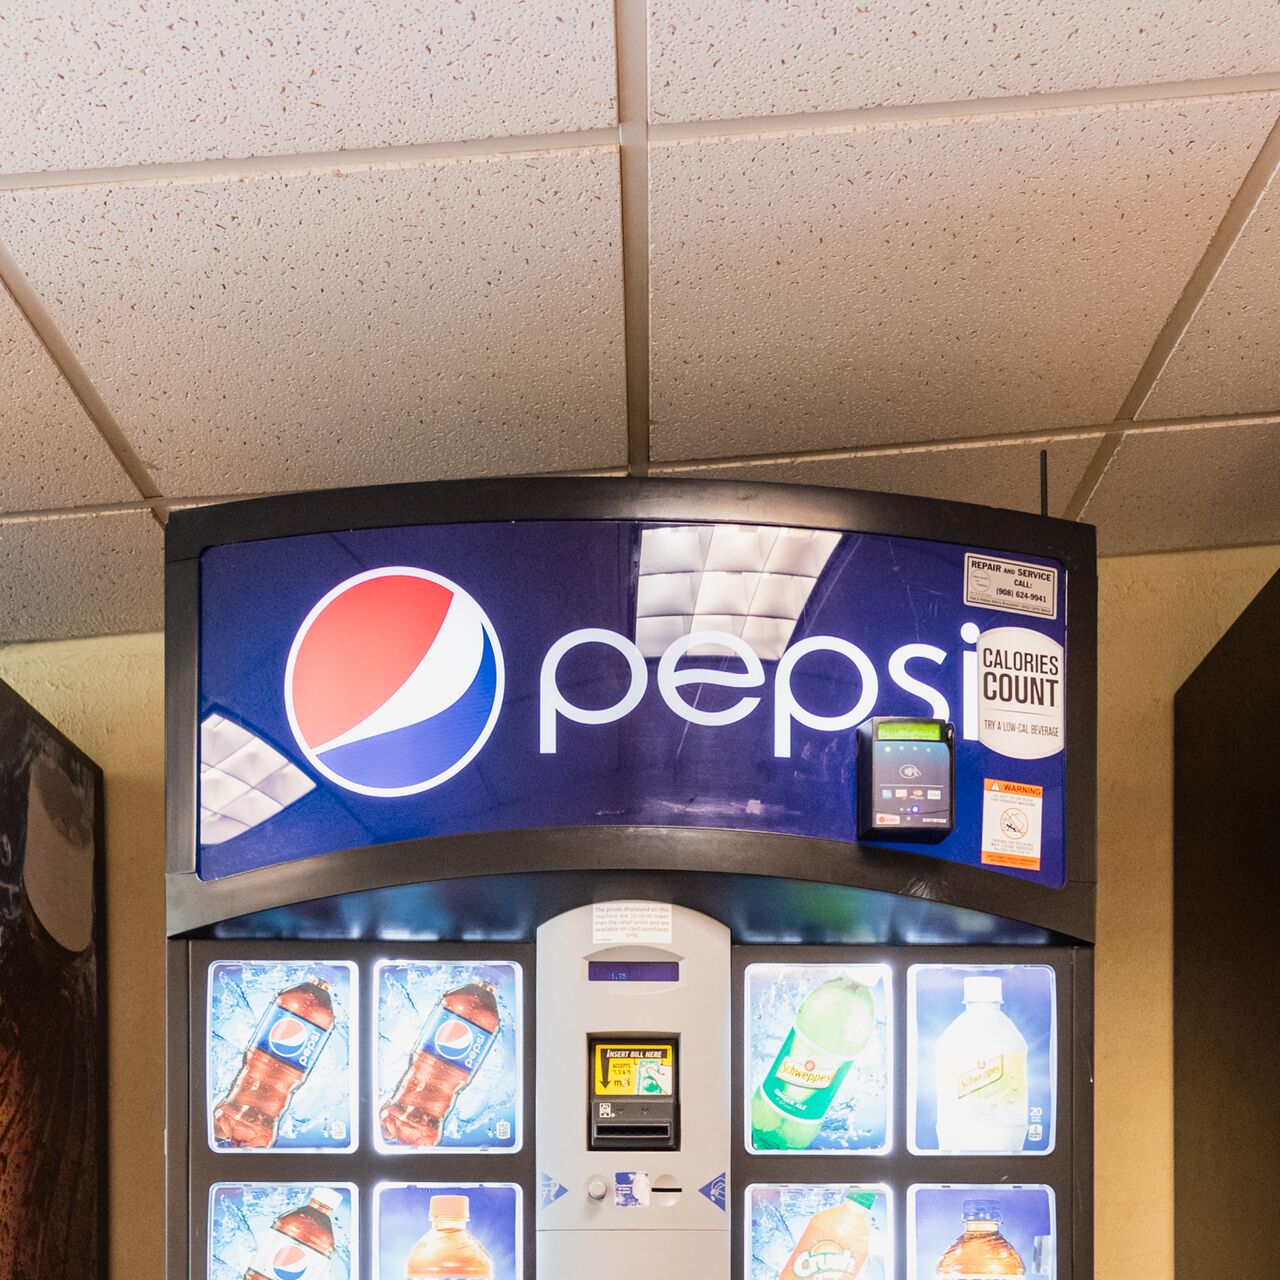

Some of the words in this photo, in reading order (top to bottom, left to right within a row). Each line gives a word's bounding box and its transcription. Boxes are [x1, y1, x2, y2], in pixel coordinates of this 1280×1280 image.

[971, 560, 1001, 573] REPAIR
[1017, 568, 1051, 582] SERVICE
[1014, 579, 1032, 588] CALL:
[1015, 591, 1047, 603] 624-9941
[983, 647, 1059, 676] CALORIES
[539, 621, 979, 758] pepsi
[983, 671, 1059, 707] COUNT
[984, 719, 995, 730] TRY
[997, 721, 1001, 730] A
[1003, 722, 1029, 734] LOW-CAL
[1031, 725, 1059, 737] BEVERAGE
[1003, 784, 1041, 796] WARNING
[298, 1031, 320, 1067] pepsi
[464, 1033, 486, 1069] pepsi
[606, 1049, 629, 1058] INSERT
[630, 1050, 644, 1058] BILL
[645, 1050, 663, 1058] HERE
